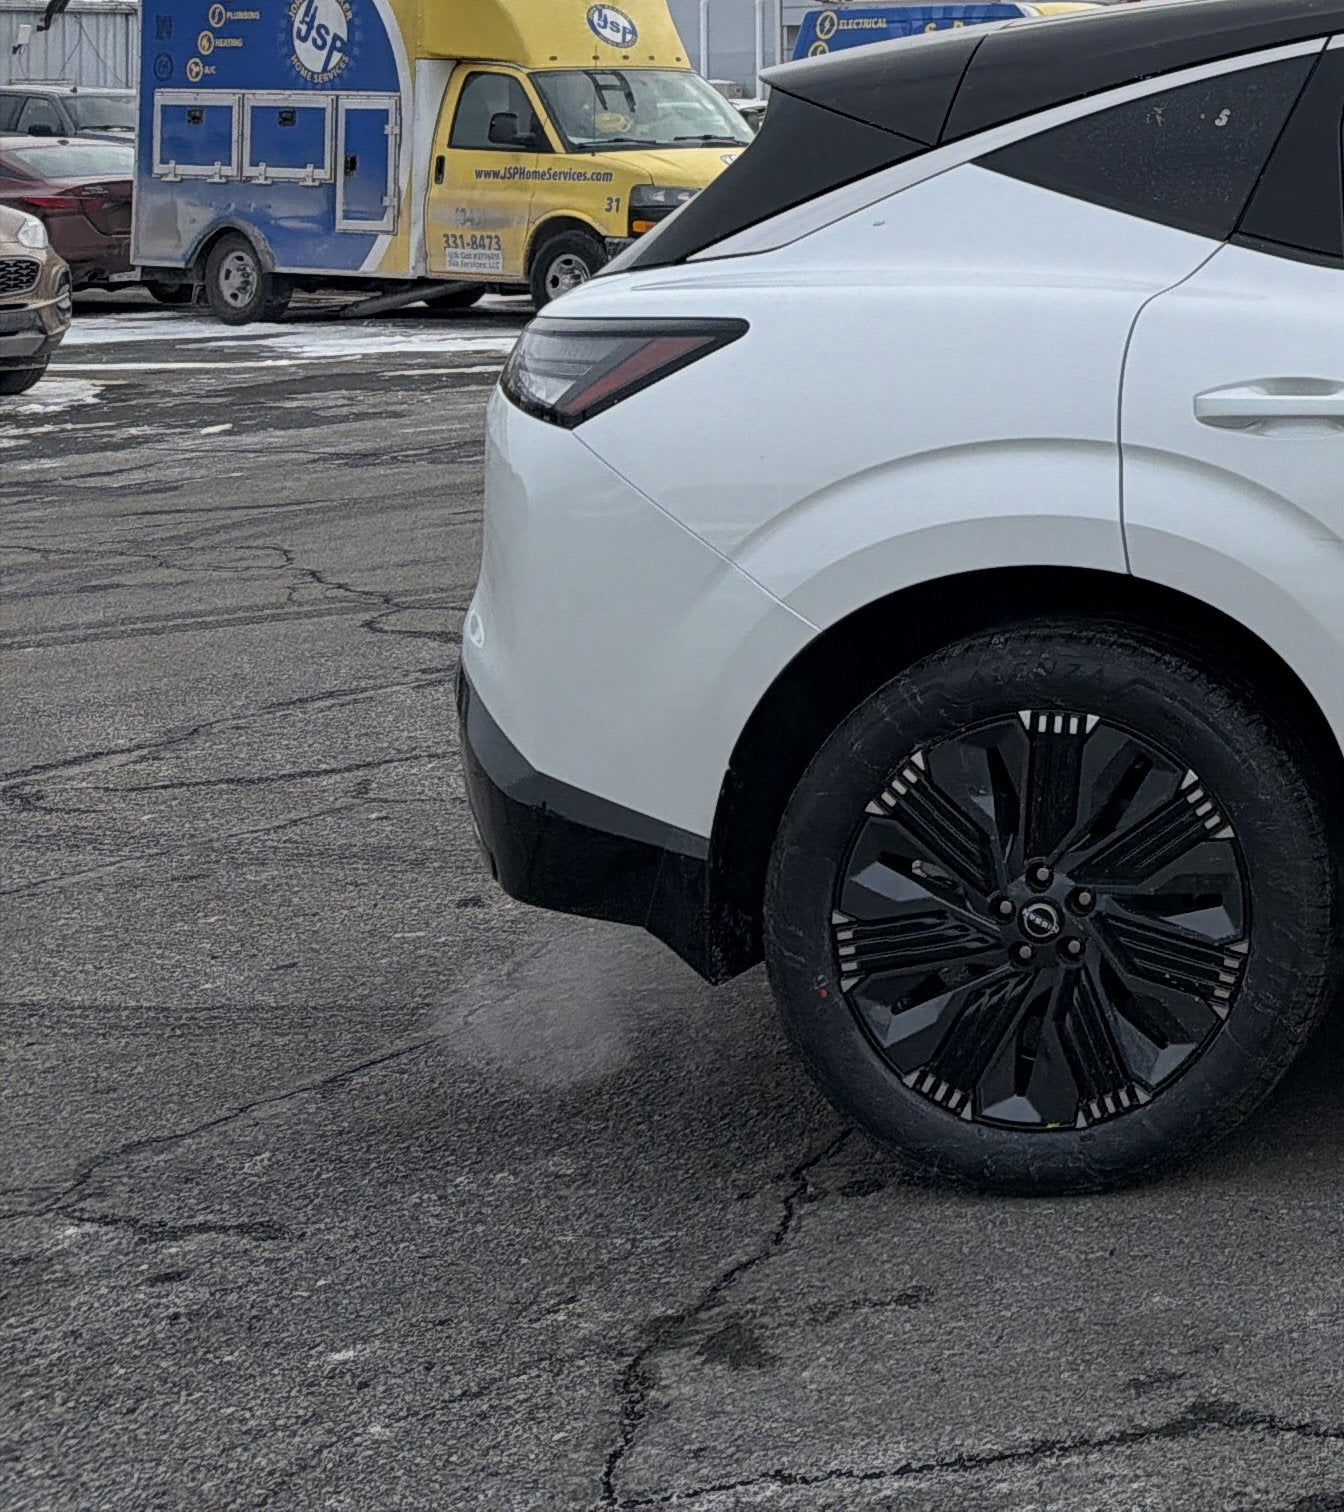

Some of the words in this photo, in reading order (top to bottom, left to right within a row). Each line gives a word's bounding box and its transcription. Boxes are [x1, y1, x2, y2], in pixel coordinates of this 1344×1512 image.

[838, 18, 888, 30] ELECTRICAL
[290, 55, 312, 82] HOME
[312, 55, 349, 85] SERVICES
[474, 166, 613, 183] www.JSPHomeServices.com
[604, 196, 621, 214] 31
[442, 233, 502, 251] 331-8473
